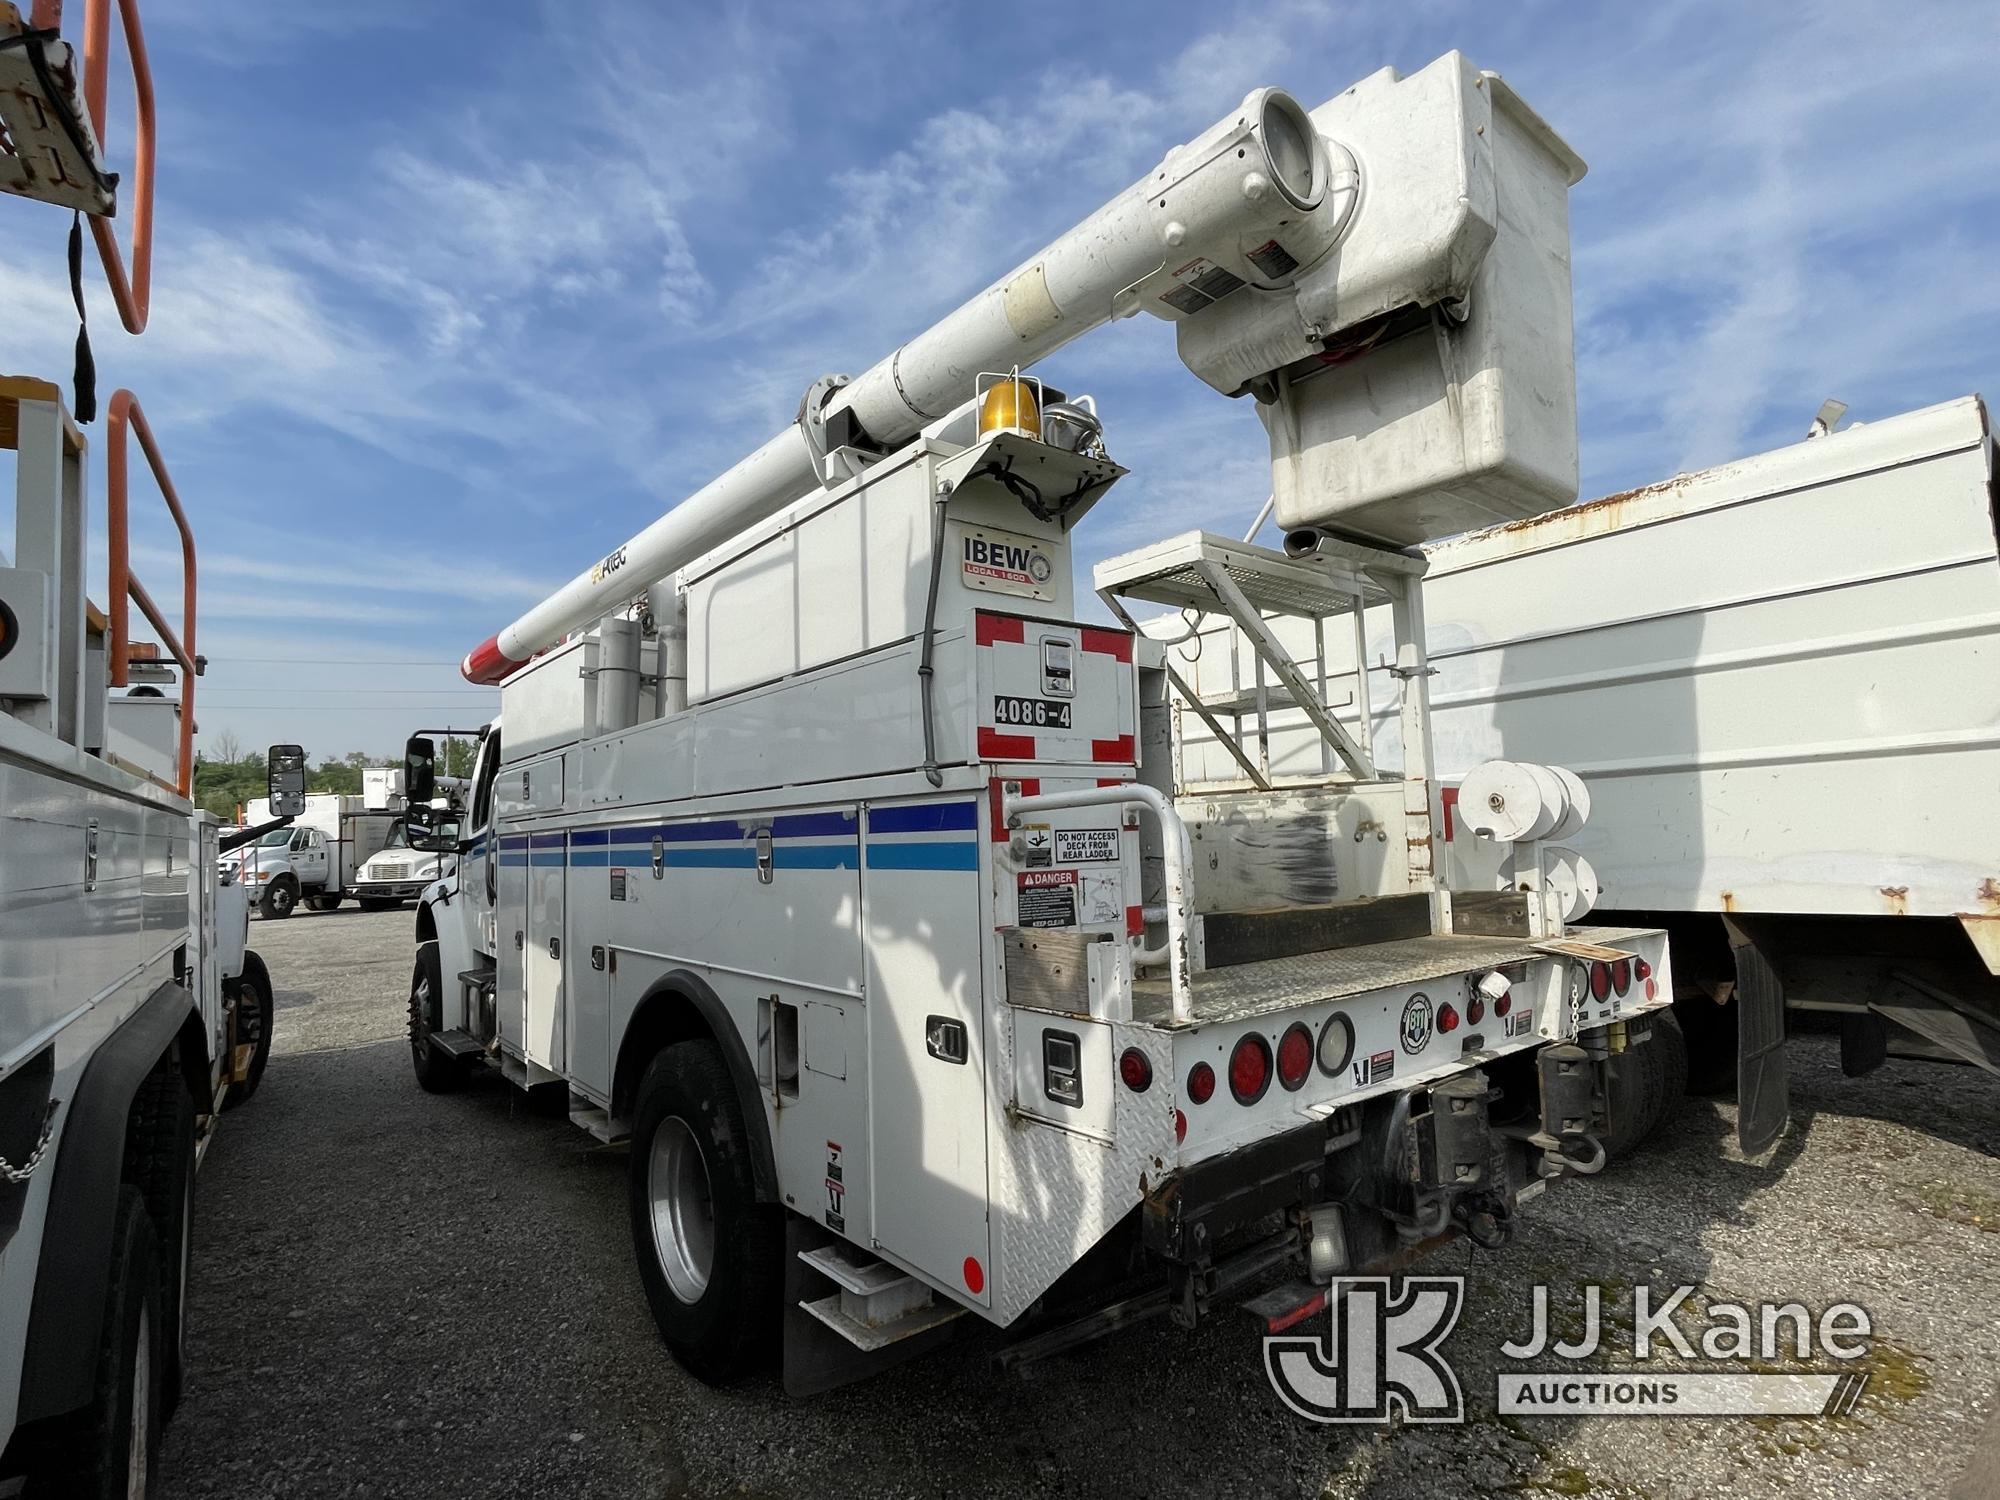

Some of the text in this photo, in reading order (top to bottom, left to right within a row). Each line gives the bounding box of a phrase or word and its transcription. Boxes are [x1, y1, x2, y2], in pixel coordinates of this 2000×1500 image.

[965, 537, 1030, 571] IBEW
[967, 565, 1026, 582] LOCAL 1600
[996, 699, 1071, 727] 4086-4
[1058, 832, 1116, 842] DO NOT ACCESS
[1066, 841, 1109, 850] DECK FROM
[1063, 850, 1113, 859] REAR LADDER
[1035, 873, 1072, 885] DANGER
[1409, 1008, 1425, 1031] 811
